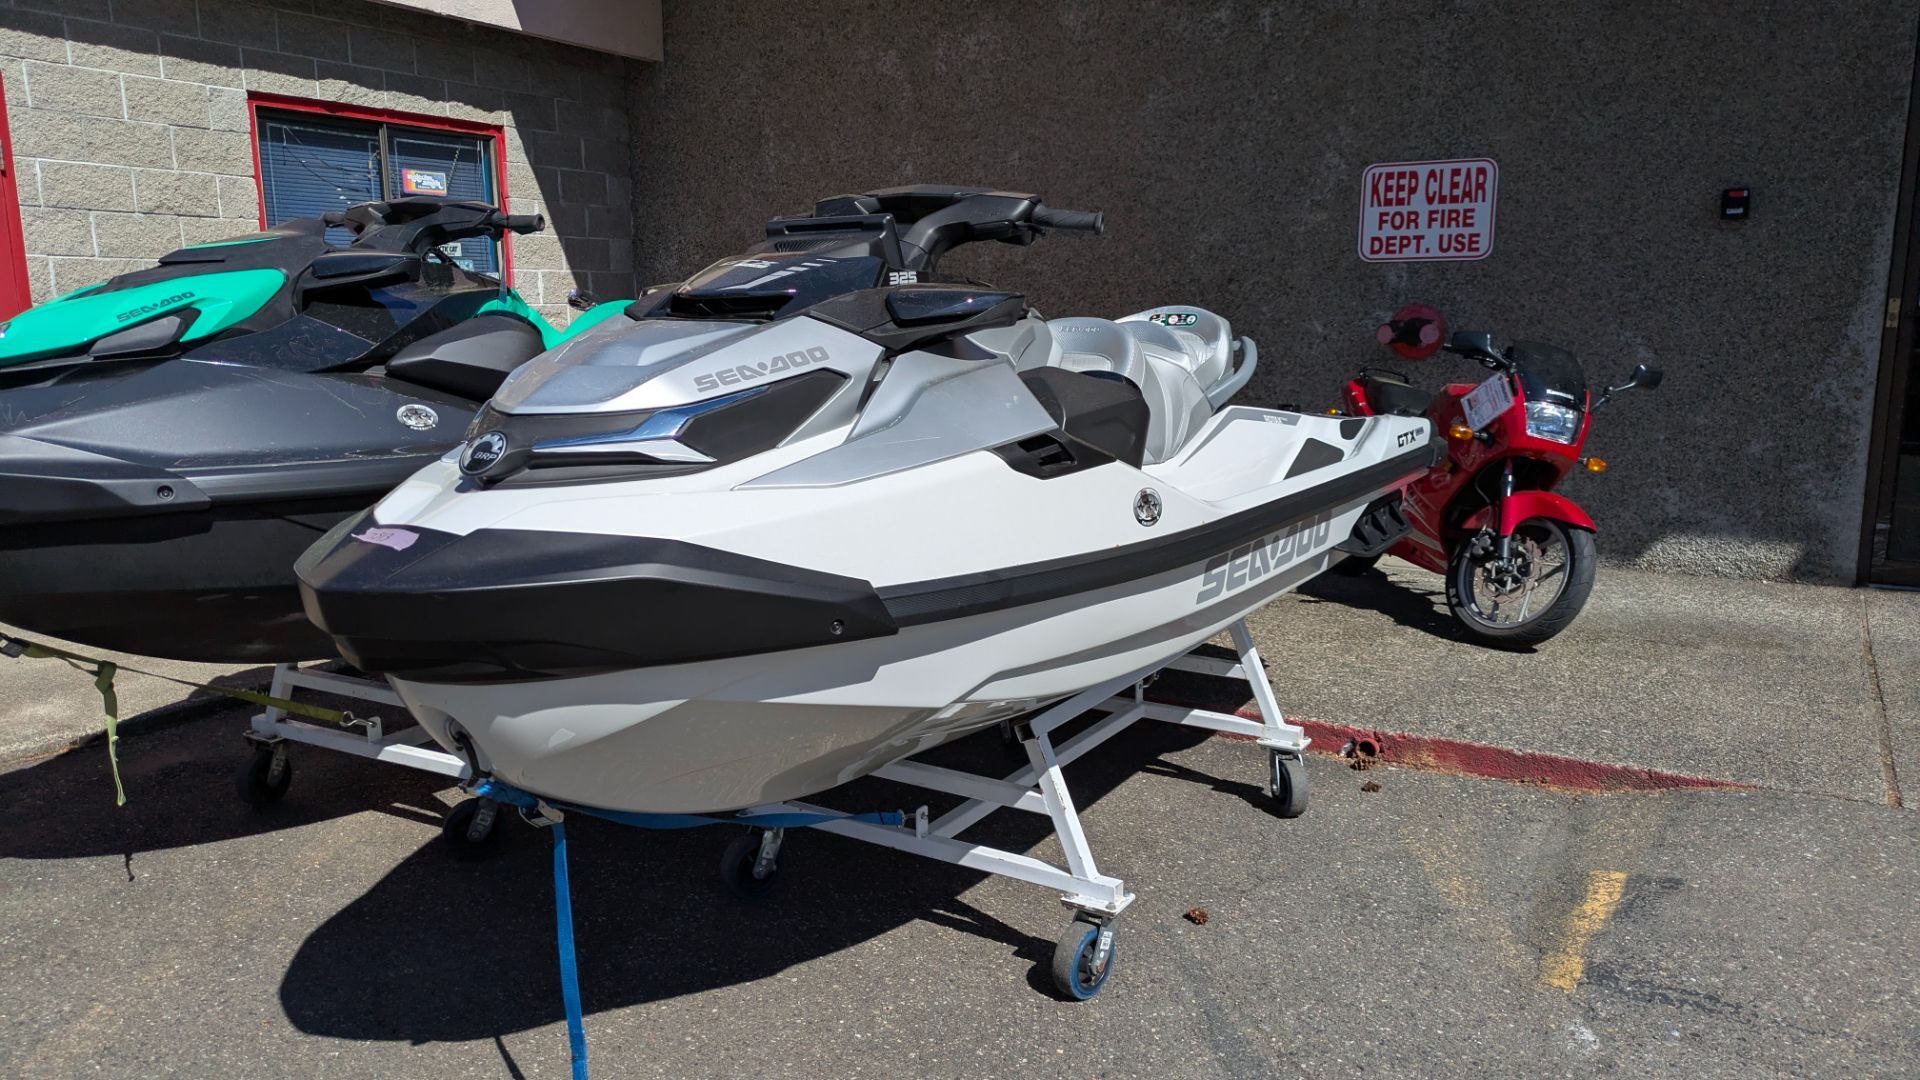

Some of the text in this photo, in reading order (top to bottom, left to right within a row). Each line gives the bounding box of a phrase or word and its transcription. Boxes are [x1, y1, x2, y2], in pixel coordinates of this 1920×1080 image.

[1370, 166, 1487, 208] KEEP CLEAR
[1378, 208, 1476, 231] FOR FIRE
[1369, 233, 1481, 255] DEPT. USE
[889, 271, 918, 285] 325
[1397, 429, 1417, 449] GTX
[473, 451, 498, 461] BRP
